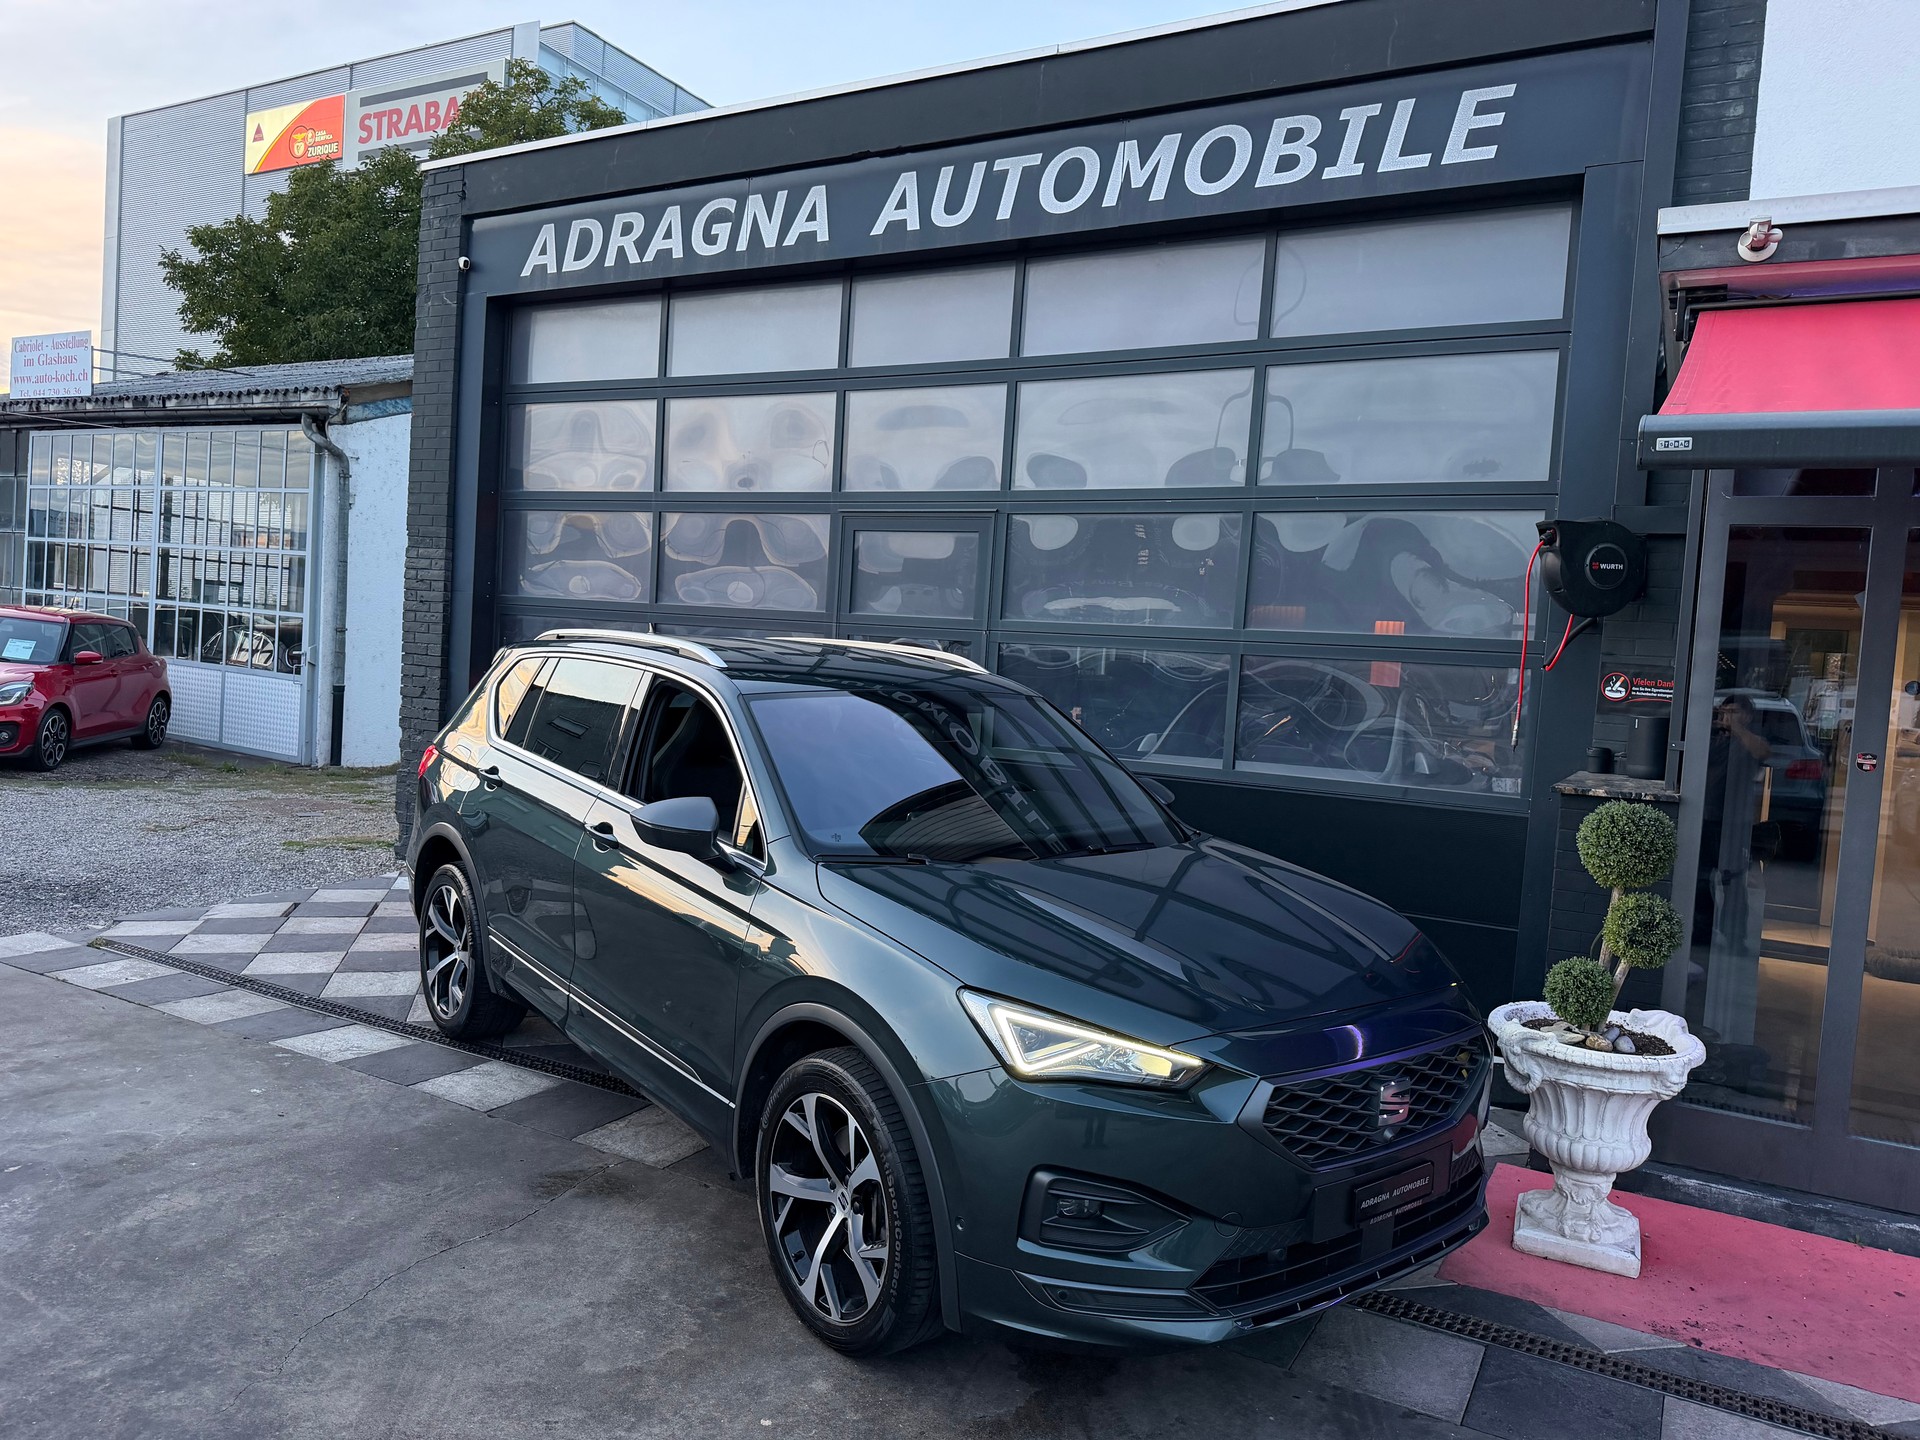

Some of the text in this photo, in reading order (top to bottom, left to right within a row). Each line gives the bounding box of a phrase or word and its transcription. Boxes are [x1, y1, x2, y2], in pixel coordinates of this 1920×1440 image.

[358, 96, 463, 145] STRABA
[307, 142, 339, 158] ZURIQUE
[520, 83, 1517, 278] ADRAGNA AUTOMOBILE
[14, 338, 44, 353] Cabriolet
[50, 335, 89, 351] Ausstellung
[23, 353, 78, 367] im Glashaus
[13, 369, 88, 384] www.auto-koch.ch
[48, 388, 60, 396] 730
[1633, 677, 1655, 687] Vielen
[1360, 1176, 1430, 1209] ADRAGNA AUTOMOBILE
